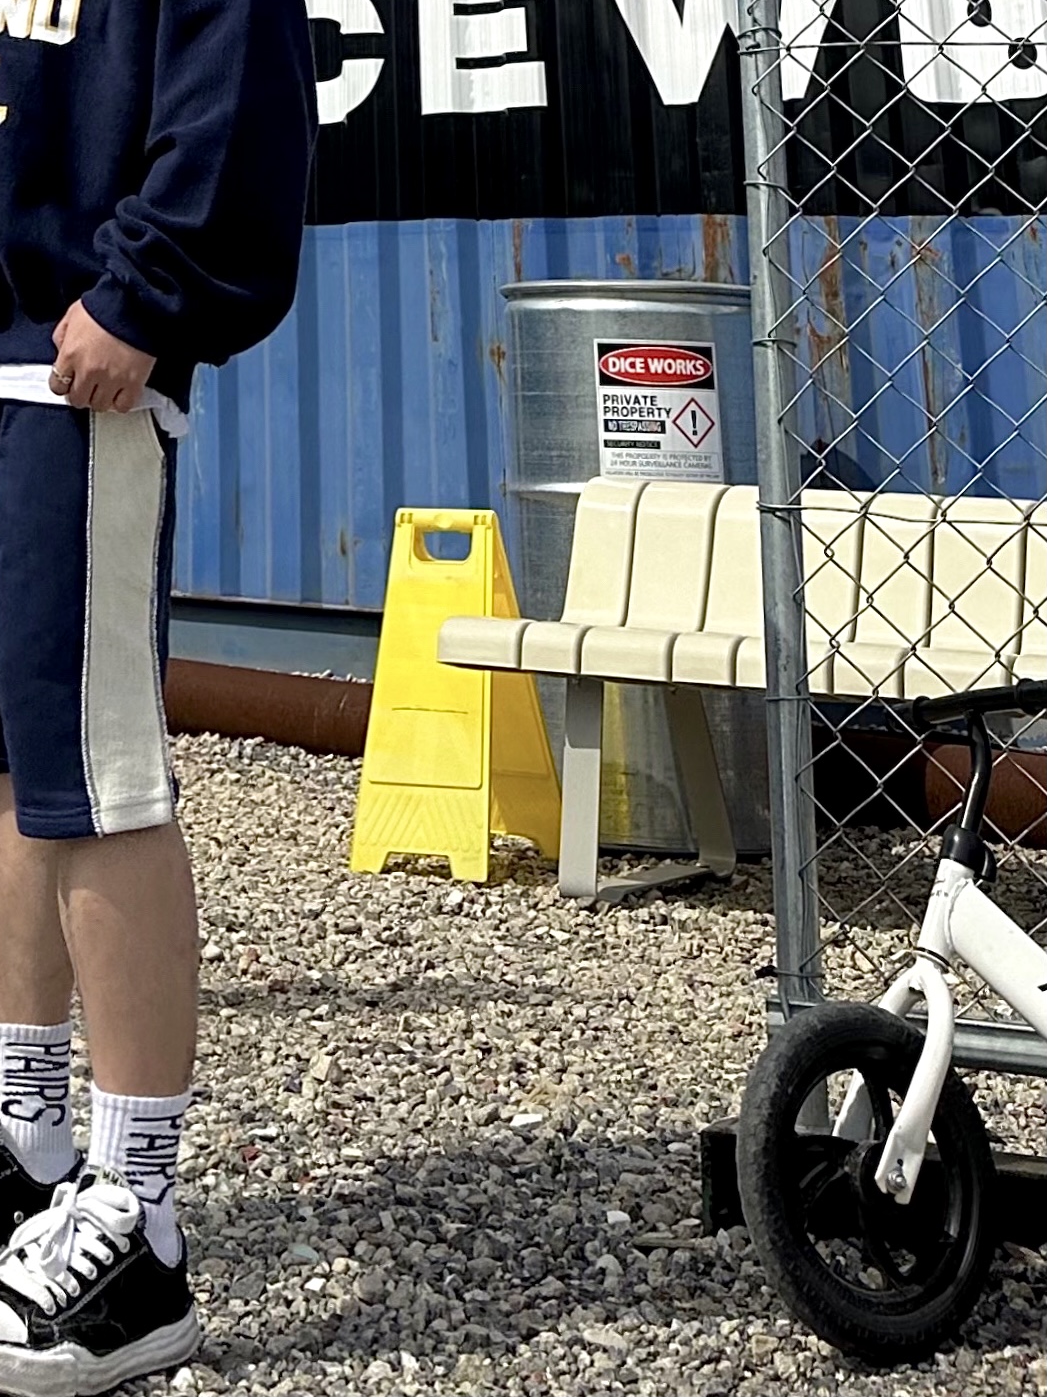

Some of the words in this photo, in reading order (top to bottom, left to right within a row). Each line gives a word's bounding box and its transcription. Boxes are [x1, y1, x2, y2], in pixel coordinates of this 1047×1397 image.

[608, 357, 645, 373] DICE
[647, 358, 705, 375] WORKS
[603, 394, 658, 406] PRIVATE
[603, 406, 672, 418] PROPERTY
[1, 1038, 71, 1127] PAIRS
